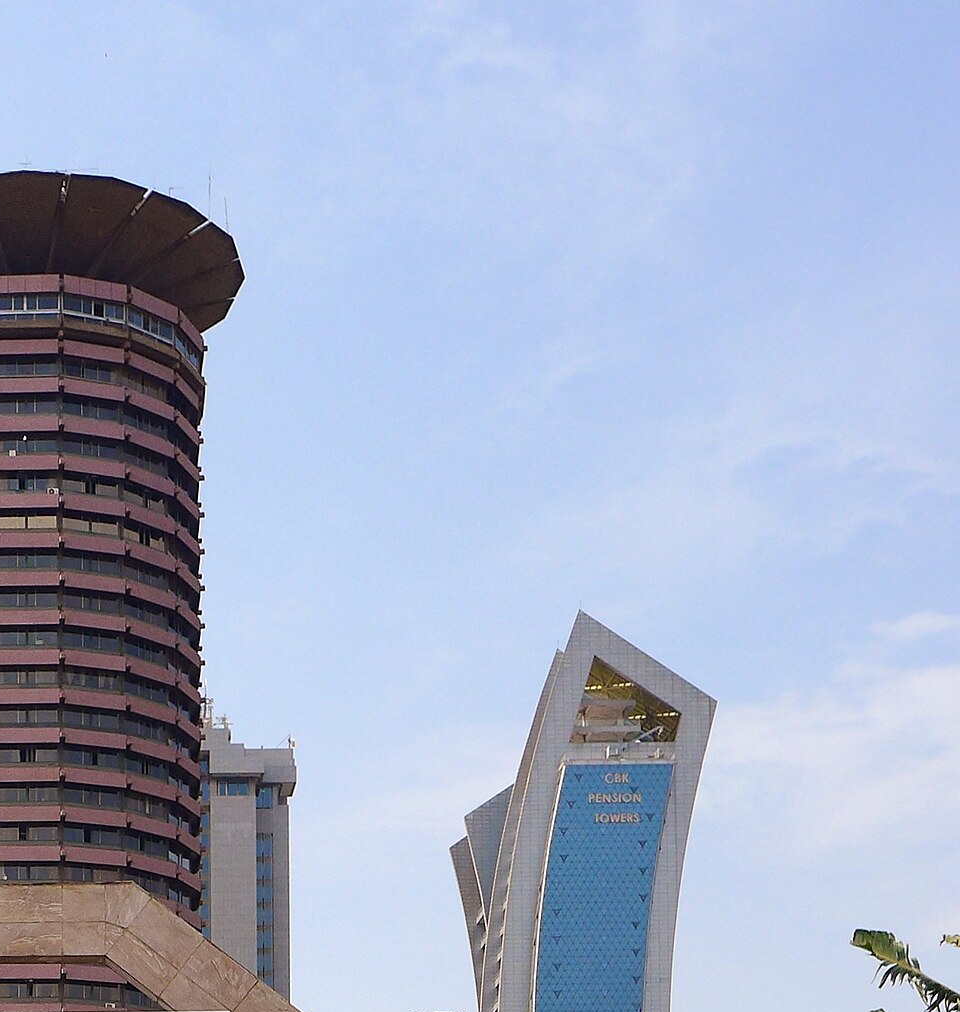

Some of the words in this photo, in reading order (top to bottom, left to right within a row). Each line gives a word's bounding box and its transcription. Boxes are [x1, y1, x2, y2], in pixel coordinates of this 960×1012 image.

[604, 772, 629, 784] CBK
[588, 793, 642, 804] PENSION
[593, 813, 640, 824] TOWERS
